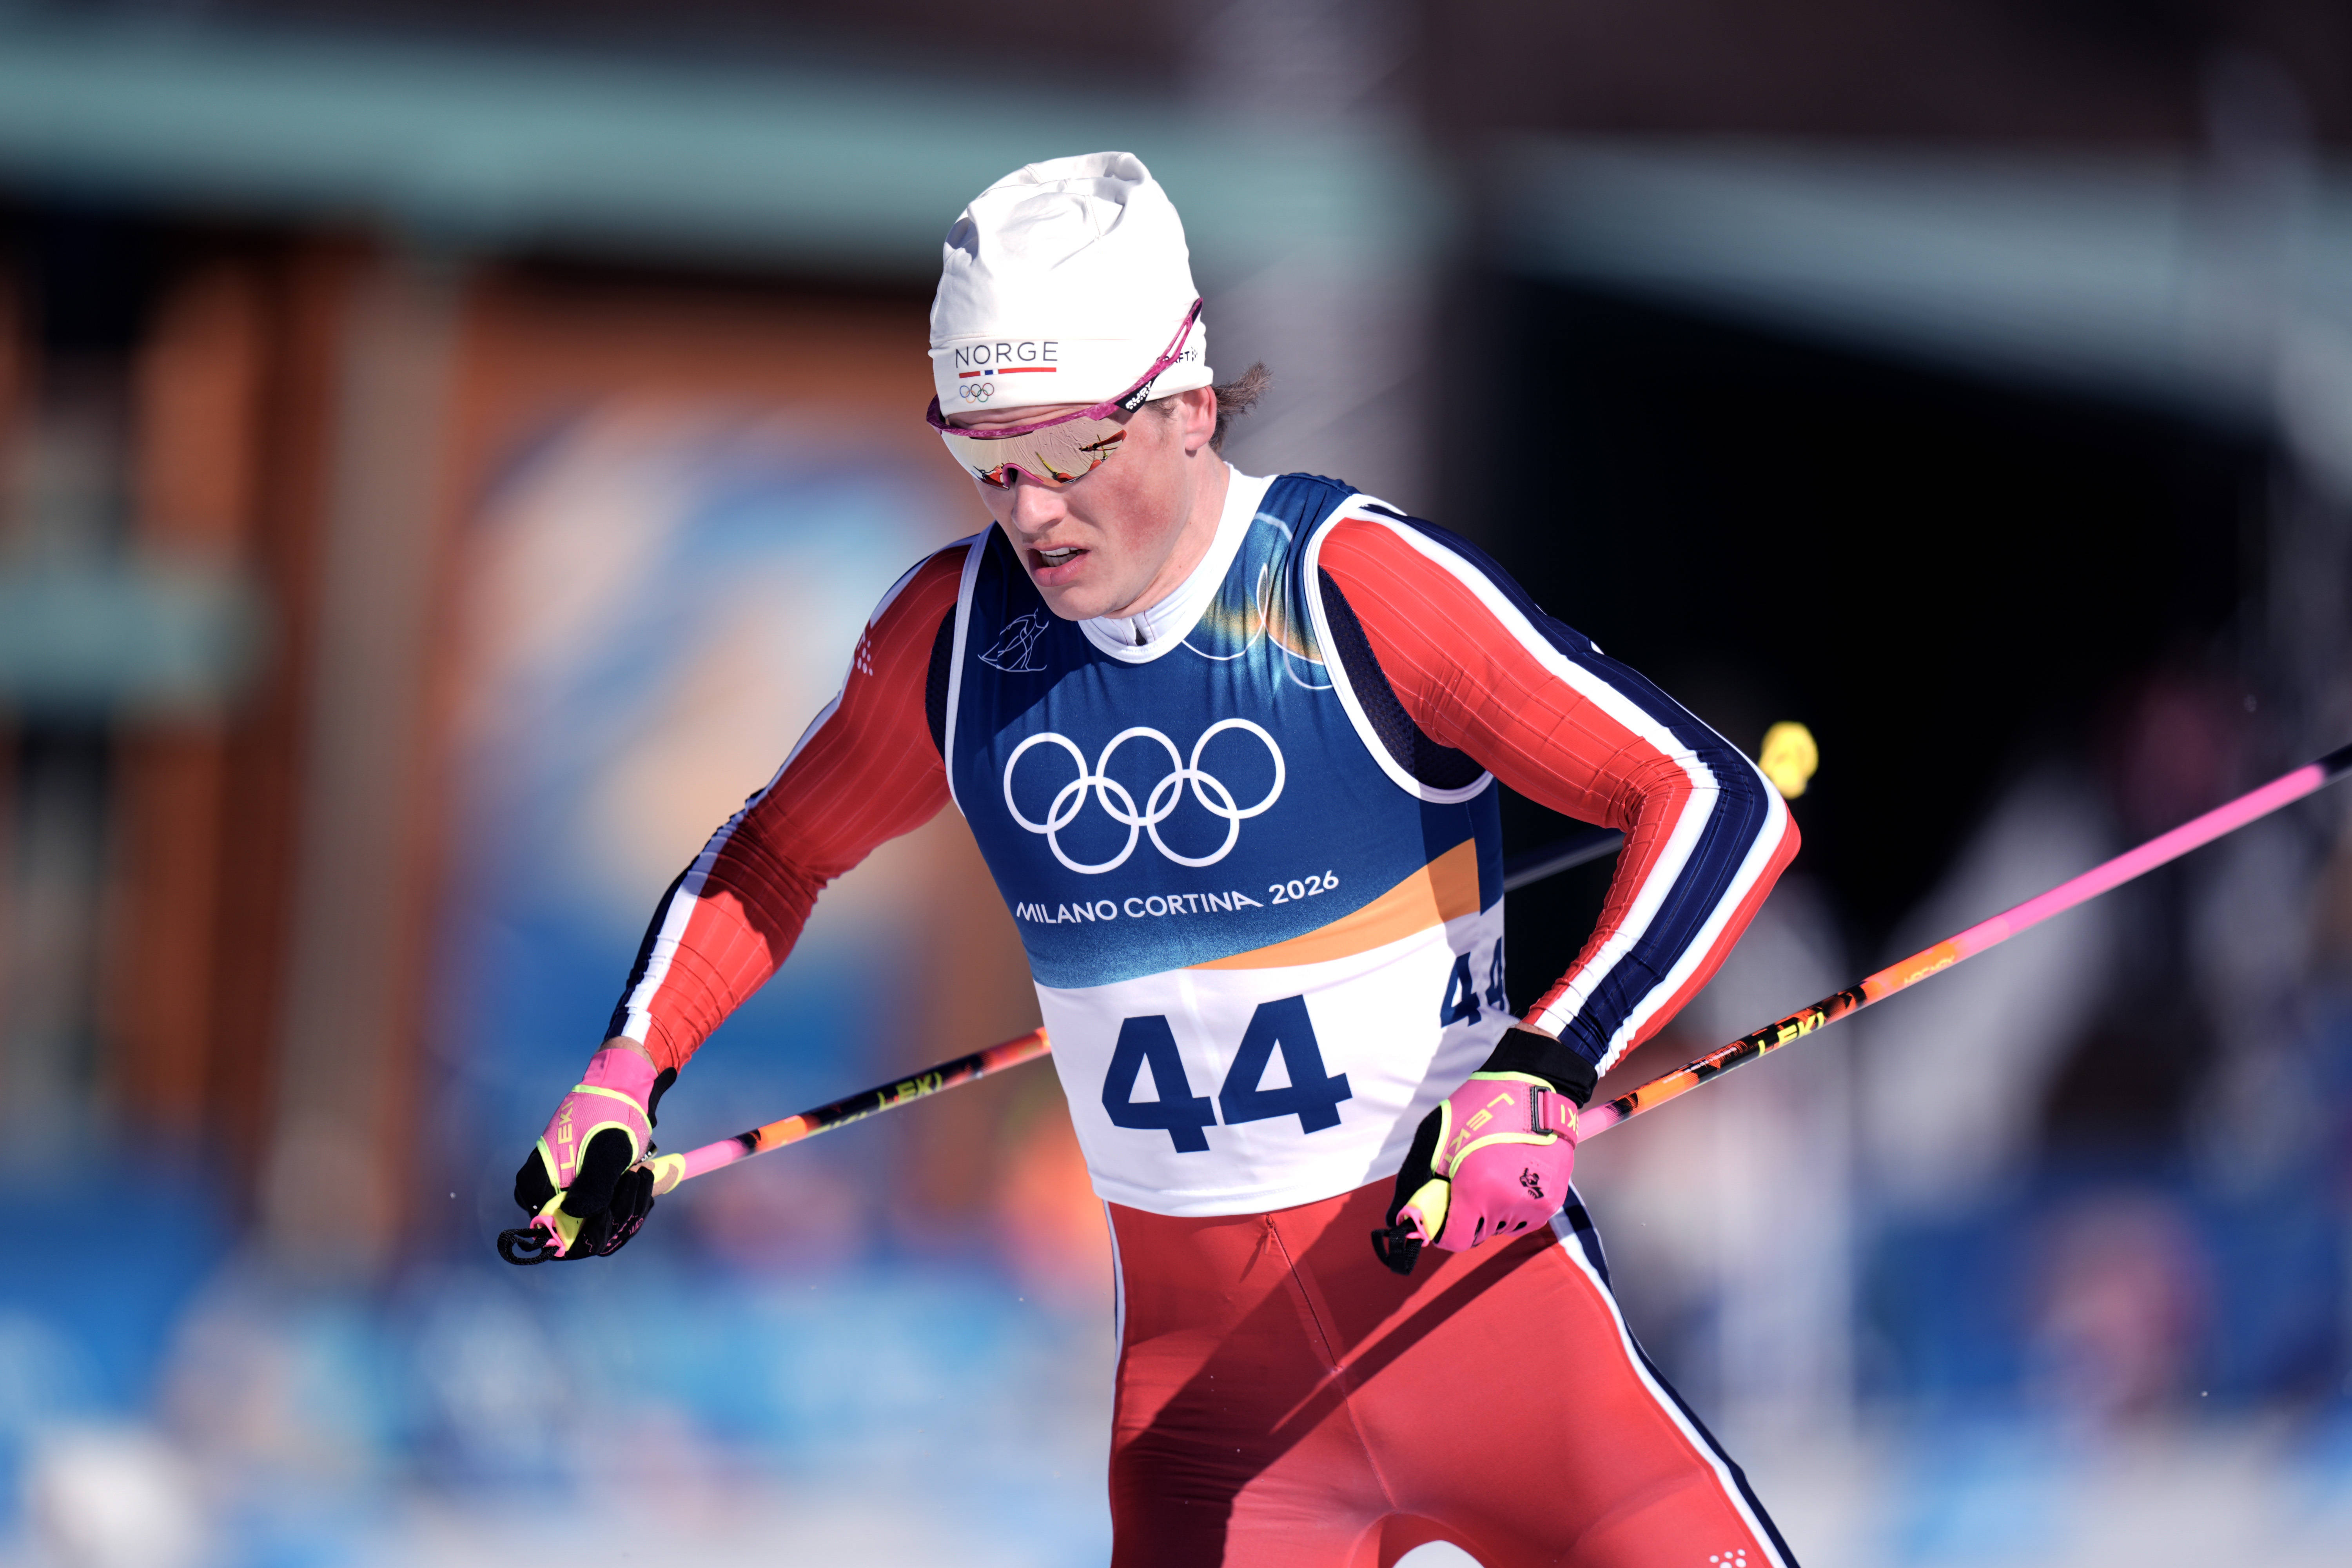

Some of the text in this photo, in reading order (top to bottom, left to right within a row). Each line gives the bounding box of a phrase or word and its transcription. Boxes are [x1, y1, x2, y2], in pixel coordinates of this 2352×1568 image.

[955, 341, 1058, 368] NORGE
[1125, 380, 1152, 408] RUDY
[1016, 870, 1339, 924] MILANO CORTINA 2026
[1440, 936, 1505, 1029] 44
[876, 1071, 944, 1111] LEKI
[1102, 994, 1353, 1153] 44
[557, 1100, 575, 1170] LEKI
[1444, 1093, 1515, 1164] LEKI
